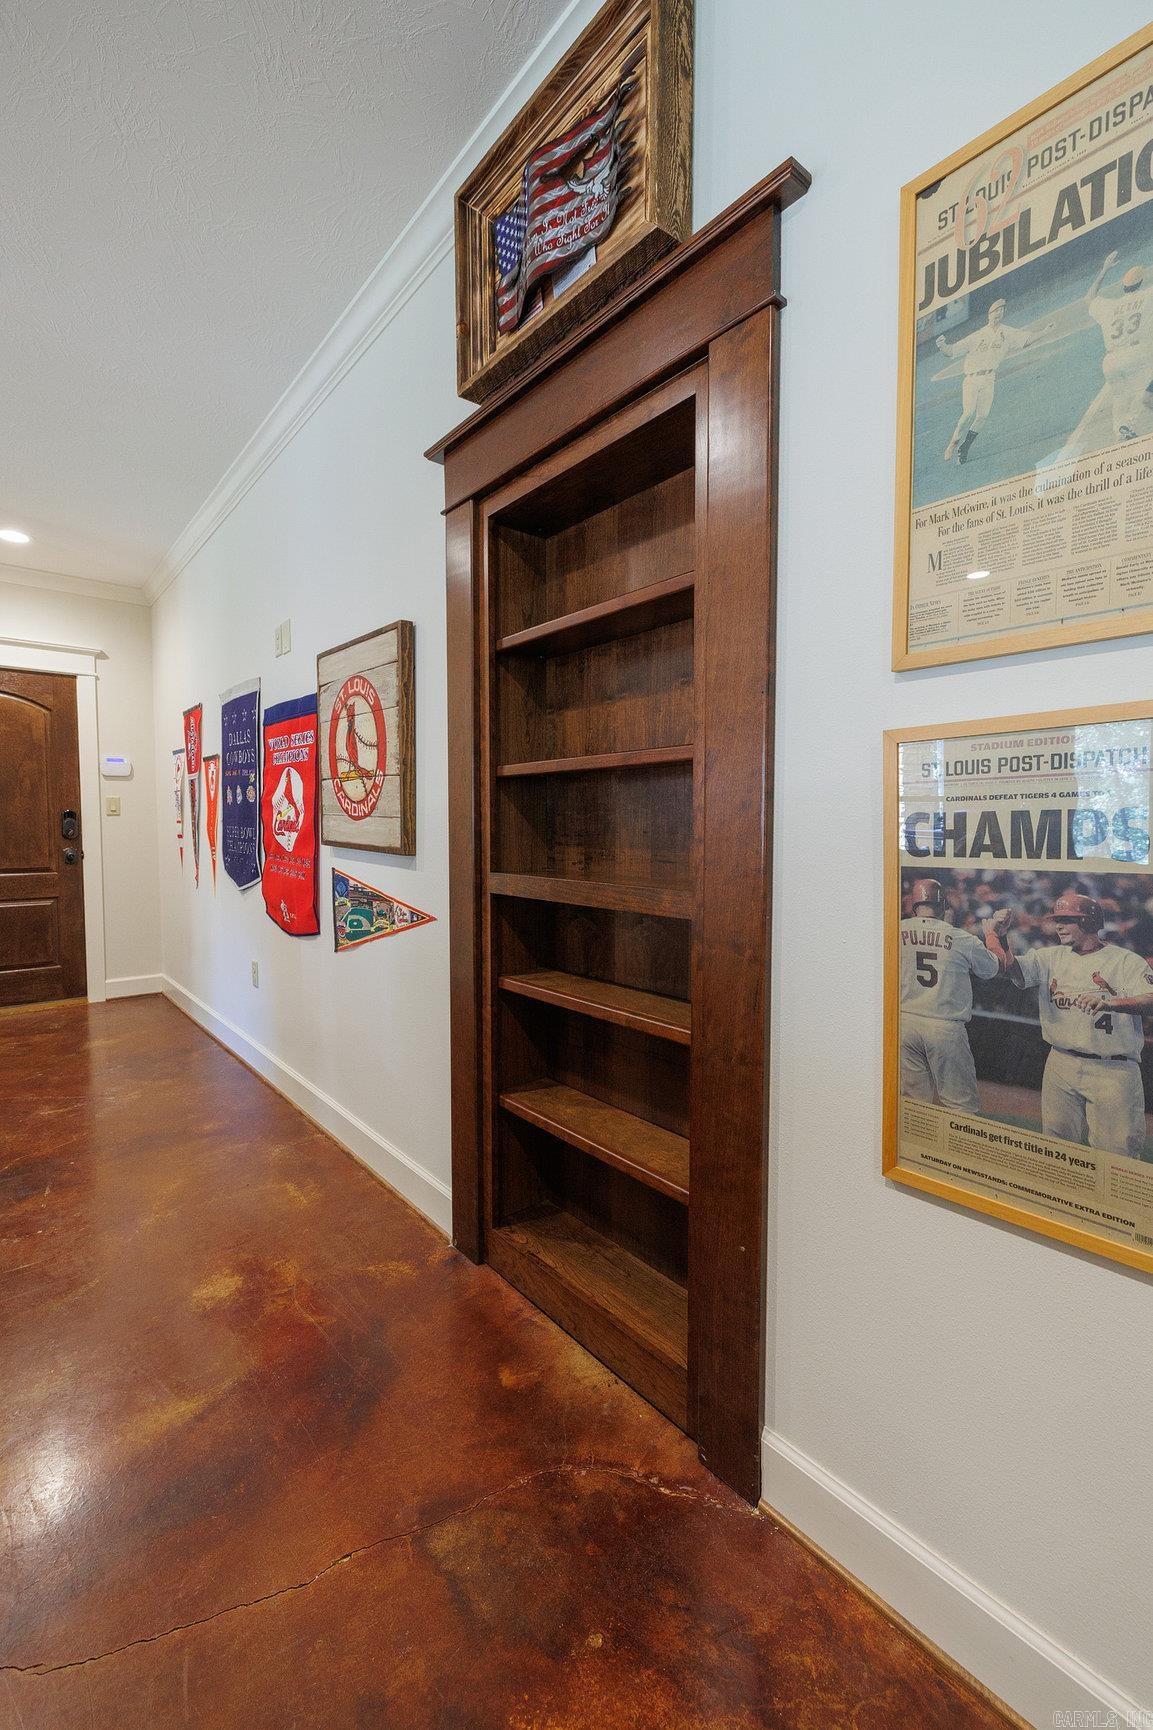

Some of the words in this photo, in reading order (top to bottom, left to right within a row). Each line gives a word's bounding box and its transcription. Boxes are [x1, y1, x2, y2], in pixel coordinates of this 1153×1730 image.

[938, 202, 959, 230] ST
[915, 518, 928, 530] For
[929, 510, 950, 525] Mark
[952, 501, 989, 519] McGwire,
[991, 496, 998, 507] it
[999, 492, 1016, 504] was
[1018, 486, 1034, 498] the
[1035, 468, 1091, 494] culmination
[1093, 461, 1105, 476] of
[1106, 463, 1113, 472] a
[937, 526, 951, 538] For
[952, 521, 965, 533] the
[966, 517, 984, 530] fans
[985, 510, 996, 524] of
[1009, 501, 1035, 518] Louis,
[1037, 497, 1044, 509] it
[1046, 493, 1065, 506] was
[1067, 487, 1083, 501] the
[1085, 477, 1110, 496] thrill
[1113, 472, 1125, 487] of
[1125, 474, 1132, 484] a
[347, 678, 376, 705] LOUIS
[228, 729, 251, 747] DALLAS
[970, 739, 1024, 752] STADIUM
[226, 749, 255, 766] COWBOYS
[945, 758, 991, 777] LOUIS
[997, 746, 1148, 774] POST-DISPATCH
[333, 768, 384, 816] CARDINALS
[946, 793, 988, 802] CARDINALS
[989, 793, 1018, 801] DEFEAT
[1020, 792, 1049, 800] TIGERS
[1058, 790, 1090, 799] GAMES
[903, 807, 1151, 863] CHAMPS
[902, 929, 953, 951] PUJOLS
[916, 951, 939, 988] 5
[1094, 1011, 1114, 1035] 4
[949, 1121, 988, 1139] Cardinals
[988, 1132, 1003, 1144] get
[1003, 1135, 1023, 1149] first
[1024, 1142, 1044, 1155] title
[1044, 1147, 1054, 1158] in
[1055, 1151, 1067, 1162] 24
[1068, 1156, 1096, 1171] years
[920, 1153, 952, 1167] SATURDAY
[952, 1163, 962, 1171] ON
[962, 1166, 1008, 1186] NEWSSTANDS:
[1008, 1182, 1074, 1207] COMMEMORATIVE
[1074, 1203, 1101, 1216] EXTRA
[1102, 1212, 1136, 1228] EDITION
